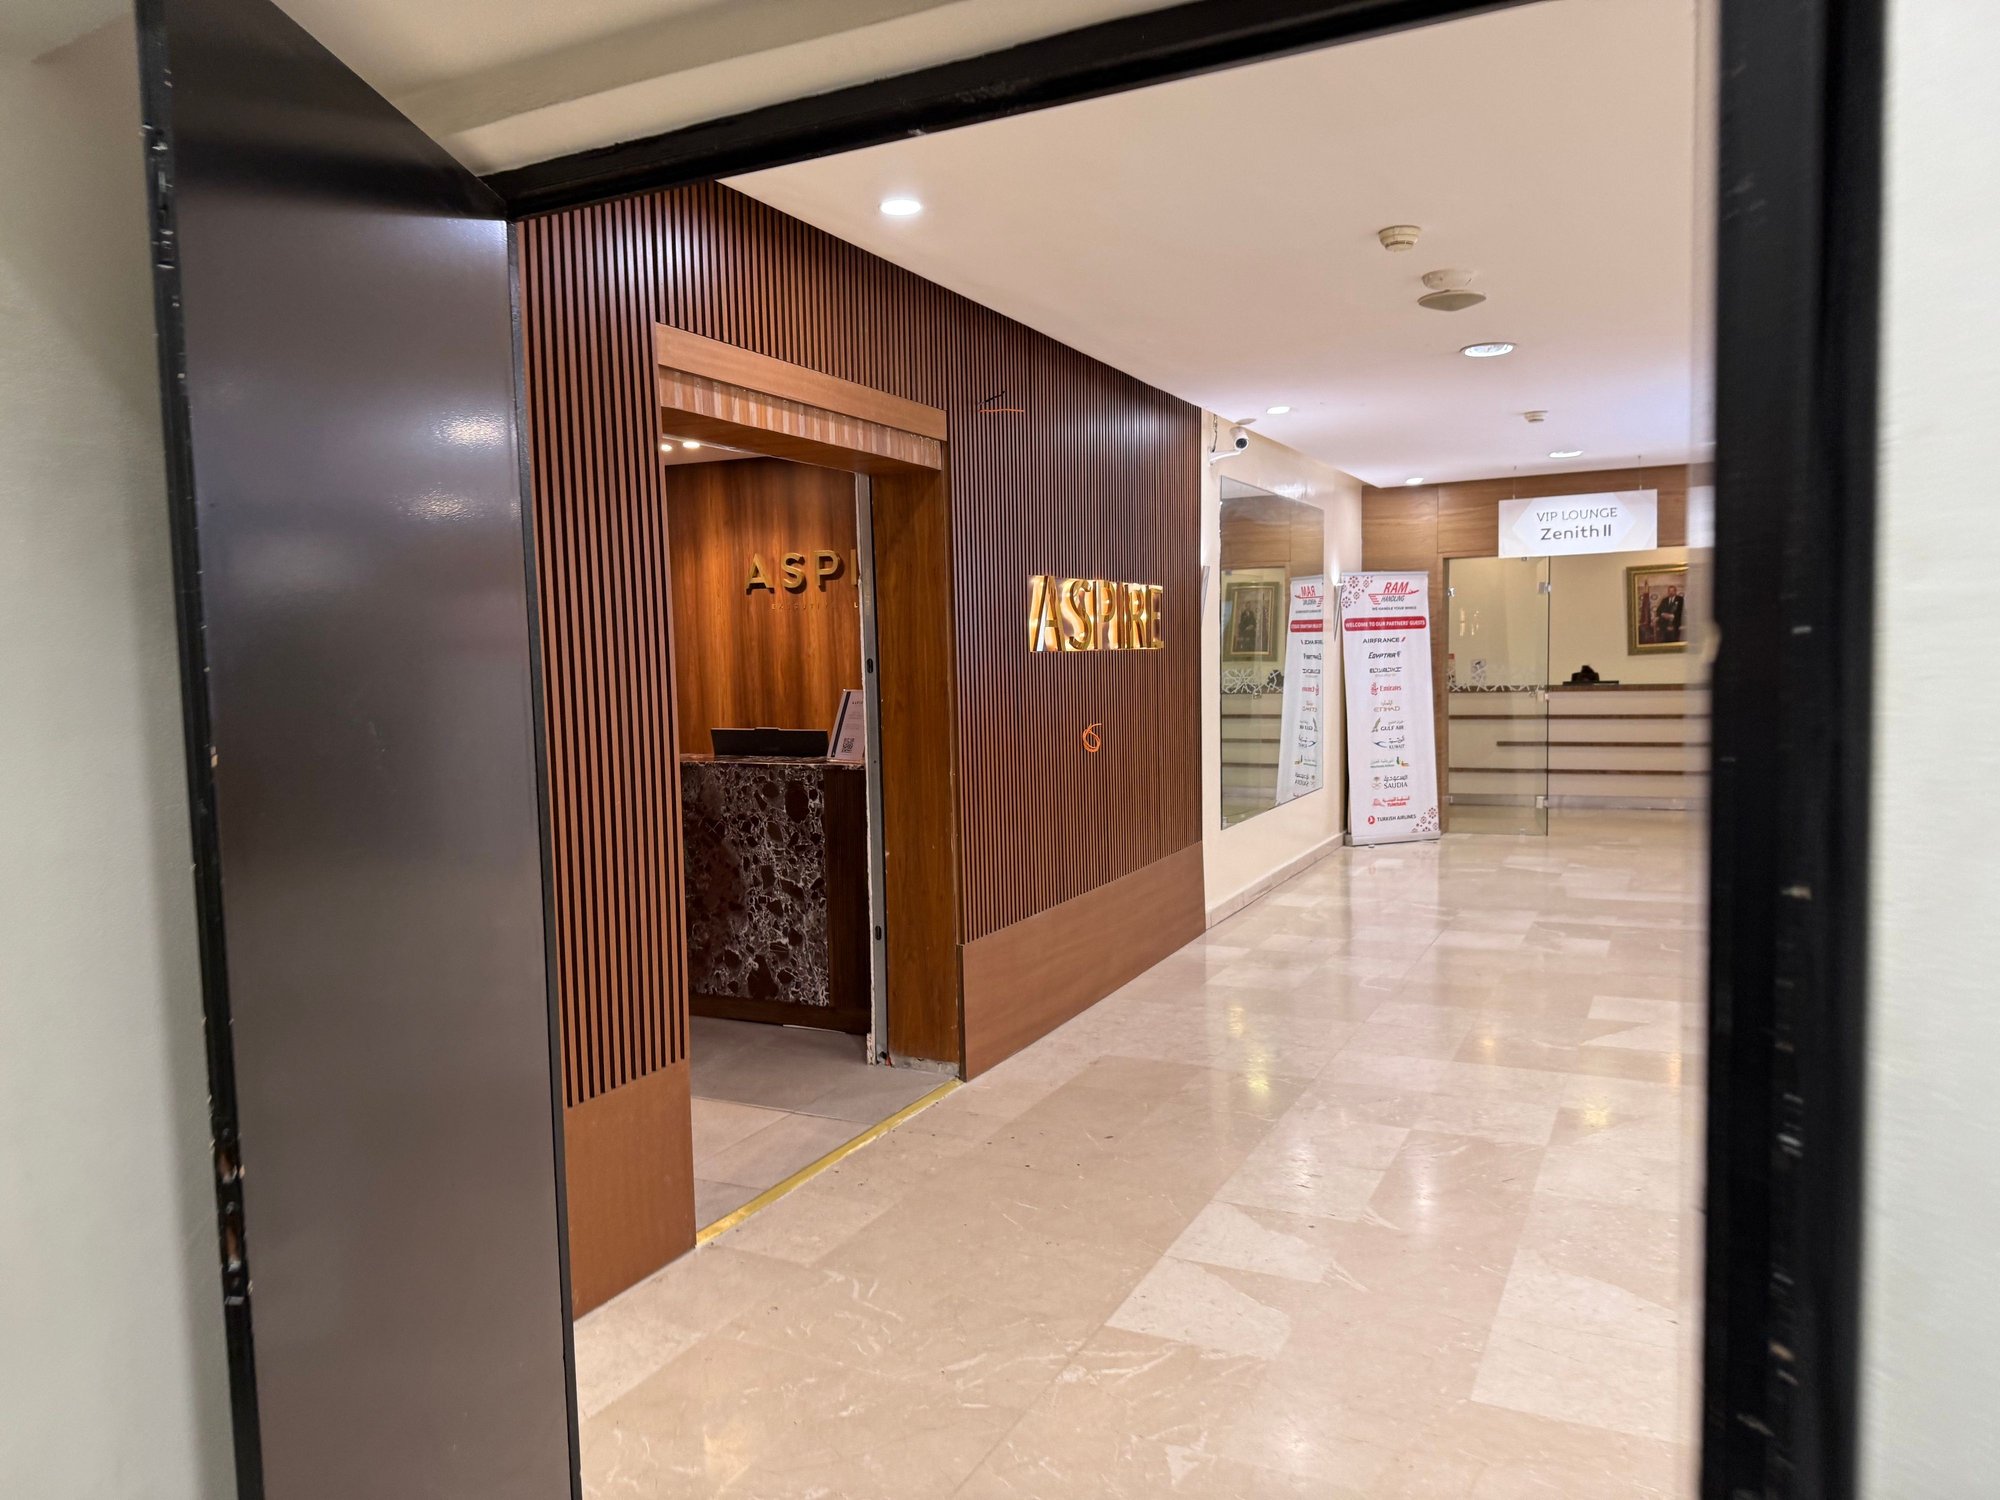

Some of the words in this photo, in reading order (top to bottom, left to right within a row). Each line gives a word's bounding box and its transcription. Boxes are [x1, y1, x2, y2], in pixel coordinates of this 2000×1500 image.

[1536, 511, 1558, 522] VIP
[1562, 507, 1618, 521] LOUNGE
[1540, 525, 1600, 541] Zenith
[1383, 581, 1410, 594] RAM
[1029, 575, 1165, 652] ASPIRE
